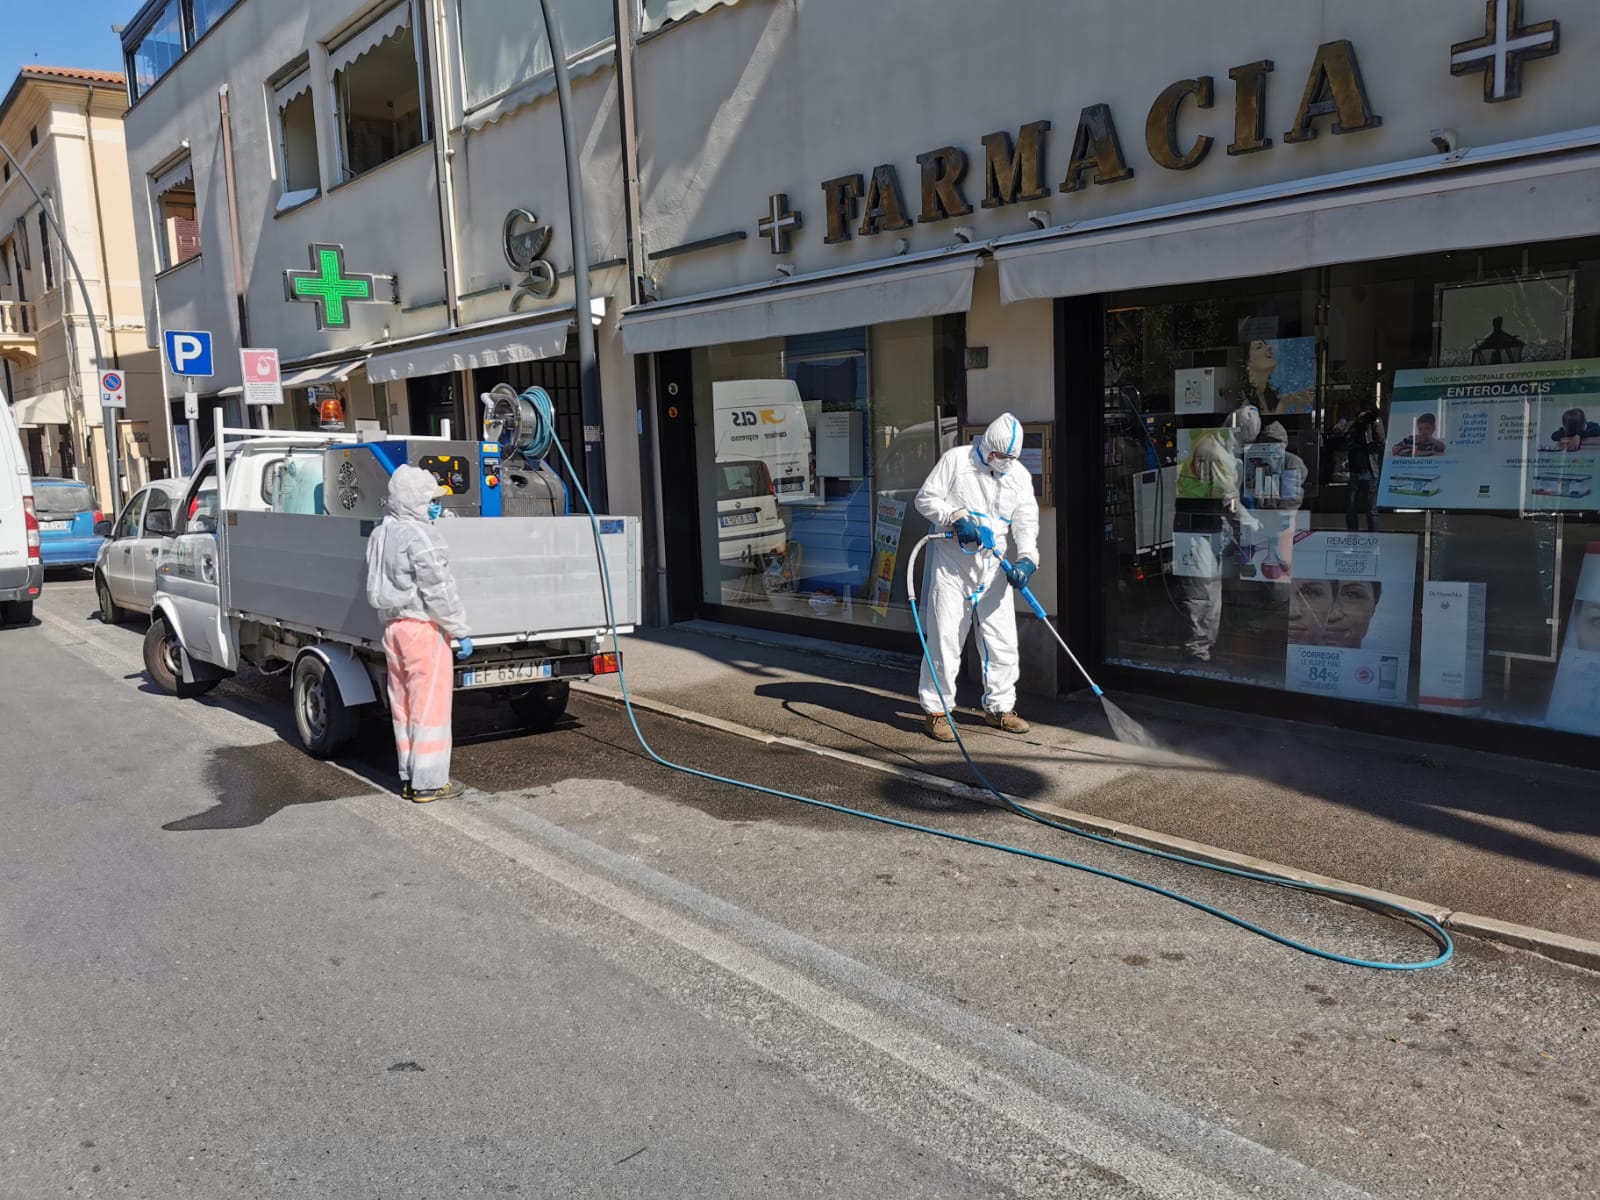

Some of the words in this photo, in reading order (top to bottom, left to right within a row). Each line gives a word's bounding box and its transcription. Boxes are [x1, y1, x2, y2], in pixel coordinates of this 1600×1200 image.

[821, 39, 1383, 245] FARMACIA
[173, 334, 203, 372] P
[1423, 375, 1450, 384] UNICO
[1462, 371, 1505, 382] ORIGINALE
[1506, 370, 1534, 380] CEPPO
[1534, 367, 1587, 379] PROBIOTICO
[1446, 382, 1552, 398] ENTEROLACTIS
[1335, 558, 1369, 569] RUGHE
[1301, 650, 1342, 660] CORREGGE
[474, 666, 492, 684] EF
[1308, 667, 1339, 682] 84%
